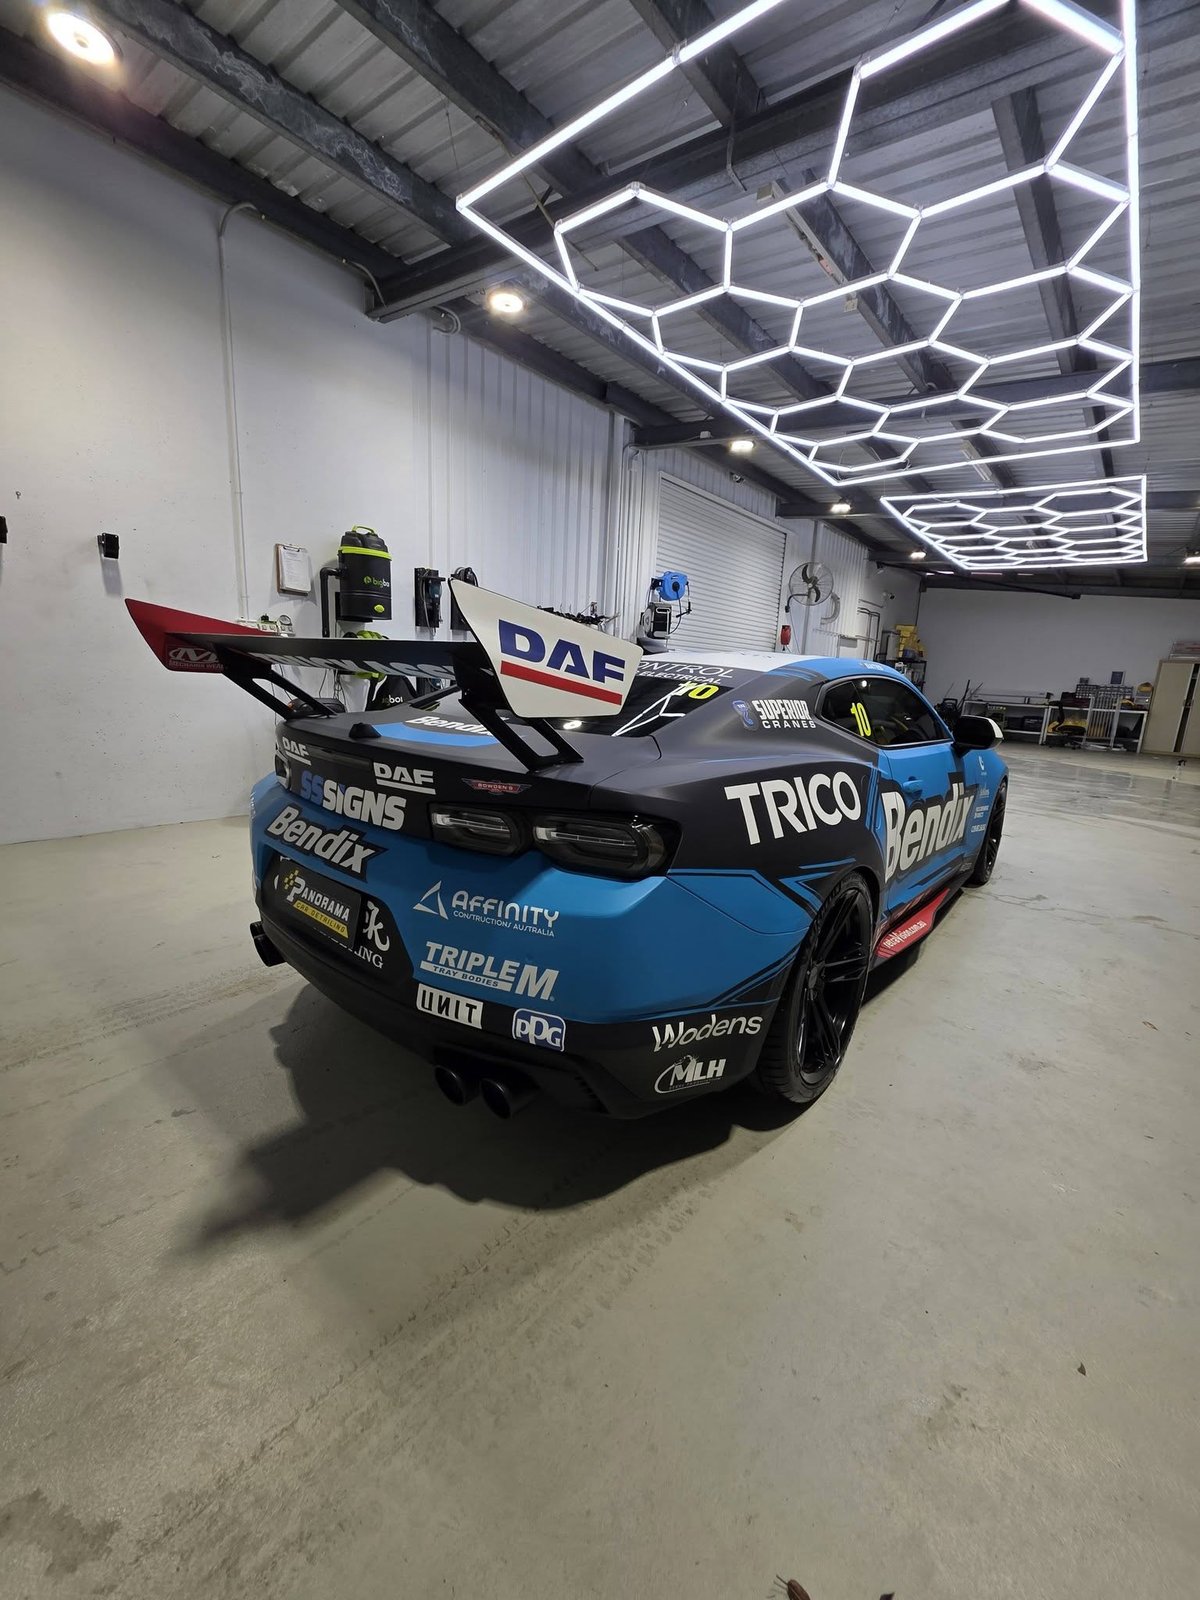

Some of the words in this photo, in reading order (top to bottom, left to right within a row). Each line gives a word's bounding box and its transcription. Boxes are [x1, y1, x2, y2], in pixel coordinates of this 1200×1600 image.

[498, 619, 626, 684] DAF
[638, 670, 721, 685] ELECTRICAL
[639, 661, 734, 679] ONTROL
[751, 699, 812, 721] SUPERIOR
[762, 720, 817, 729] CRANES
[850, 702, 872, 737] 10
[282, 736, 310, 757] DAF
[373, 761, 434, 785] DAF
[724, 771, 862, 845] TRICO
[266, 805, 376, 874] Bendix
[881, 782, 975, 884] Bendix
[296, 902, 309, 913] CAR
[311, 908, 346, 933] DETAILING
[452, 890, 560, 928] AFFINITY
[513, 923, 555, 937] AUSTRALIA
[433, 965, 459, 977] TRAY
[461, 973, 499, 988] BODIES
[421, 989, 477, 1024] UNIT
[652, 1013, 763, 1052] Wodens
[669, 1058, 727, 1086] MLH
